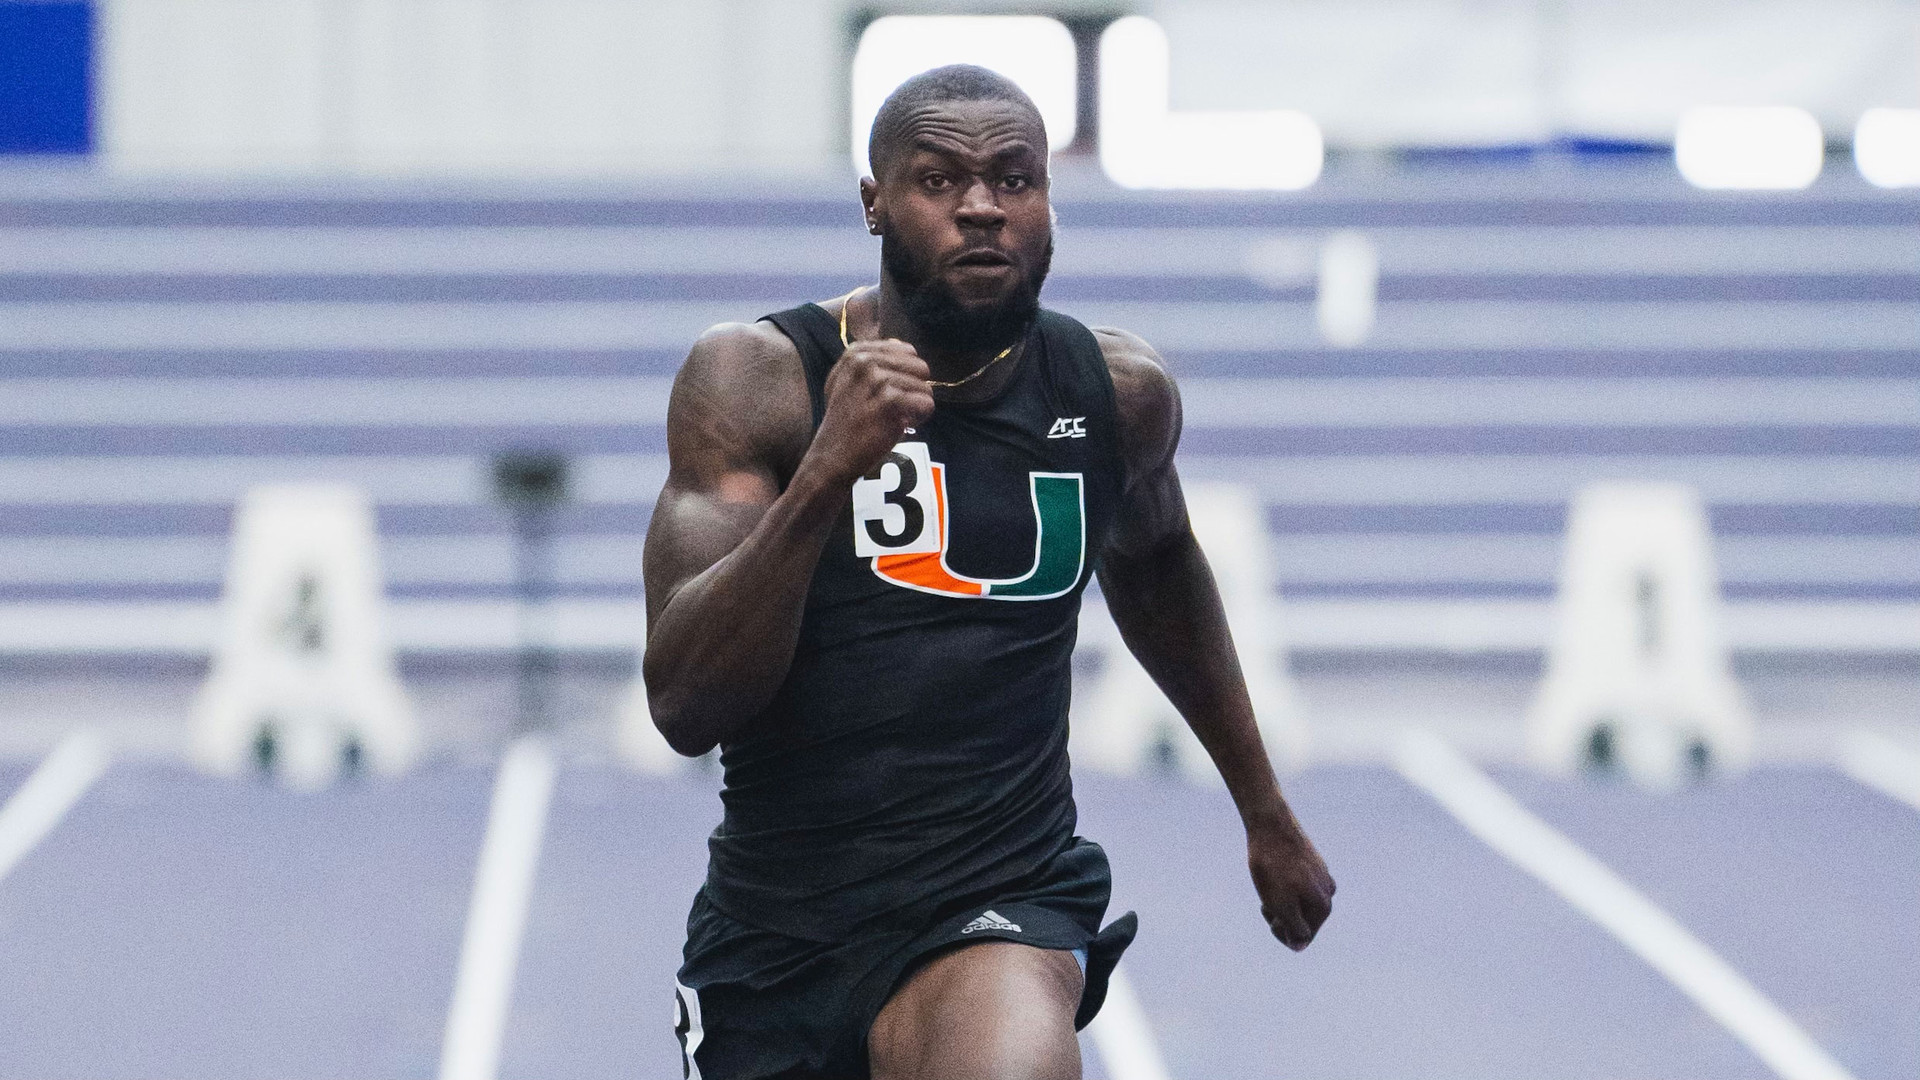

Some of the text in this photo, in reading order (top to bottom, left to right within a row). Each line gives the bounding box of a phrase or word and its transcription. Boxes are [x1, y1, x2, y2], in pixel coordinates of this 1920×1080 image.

[1047, 416, 1087, 439] ACC
[863, 450, 924, 548] 3
[870, 461, 1086, 601] U
